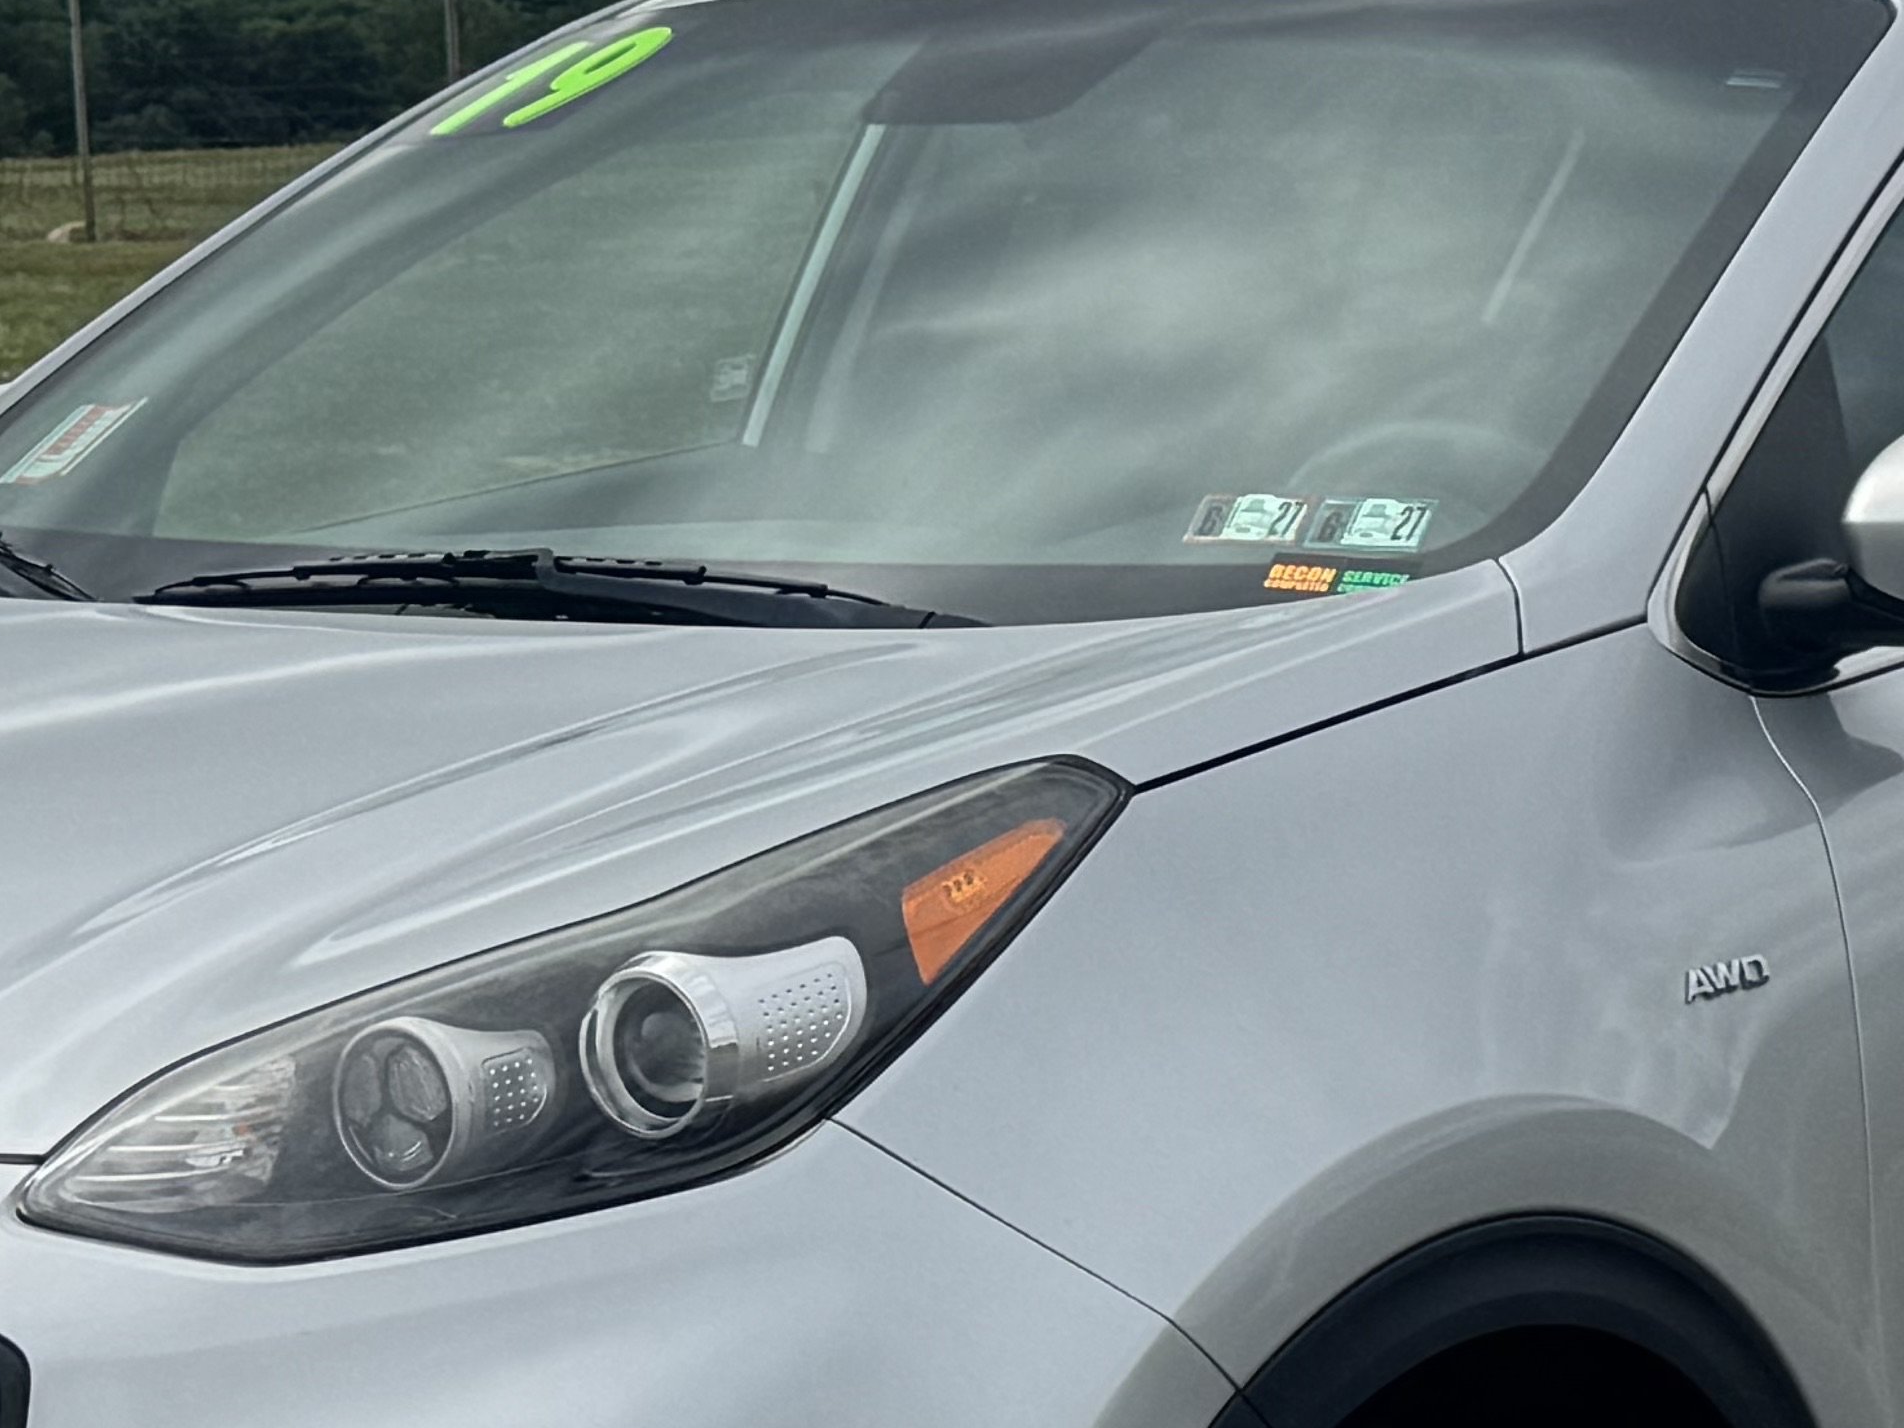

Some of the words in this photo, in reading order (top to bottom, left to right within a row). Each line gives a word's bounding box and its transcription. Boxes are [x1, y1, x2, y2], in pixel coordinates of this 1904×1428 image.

[430, 26, 673, 136] 19
[1390, 505, 1427, 541] 27
[1268, 563, 1337, 582] RECON
[1685, 954, 1771, 1004] AWD
